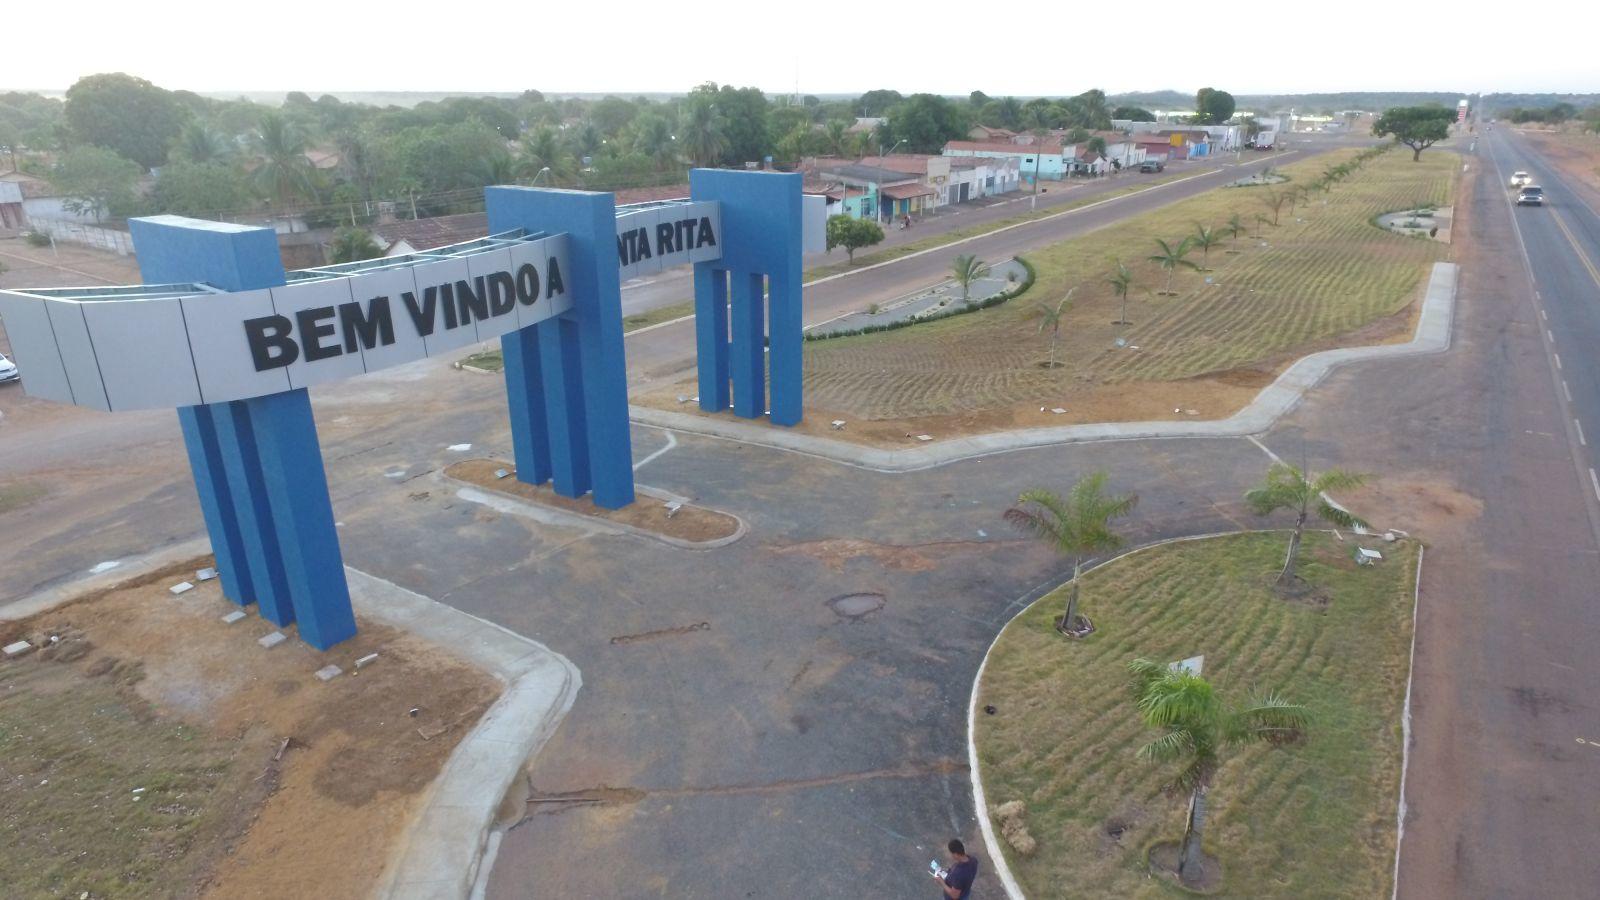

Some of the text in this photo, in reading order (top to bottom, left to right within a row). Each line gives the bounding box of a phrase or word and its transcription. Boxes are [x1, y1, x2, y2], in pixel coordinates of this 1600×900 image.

[244, 296, 395, 372] BEM
[401, 263, 540, 337] VINDO
[546, 256, 565, 299] A
[656, 216, 717, 256] RITA
